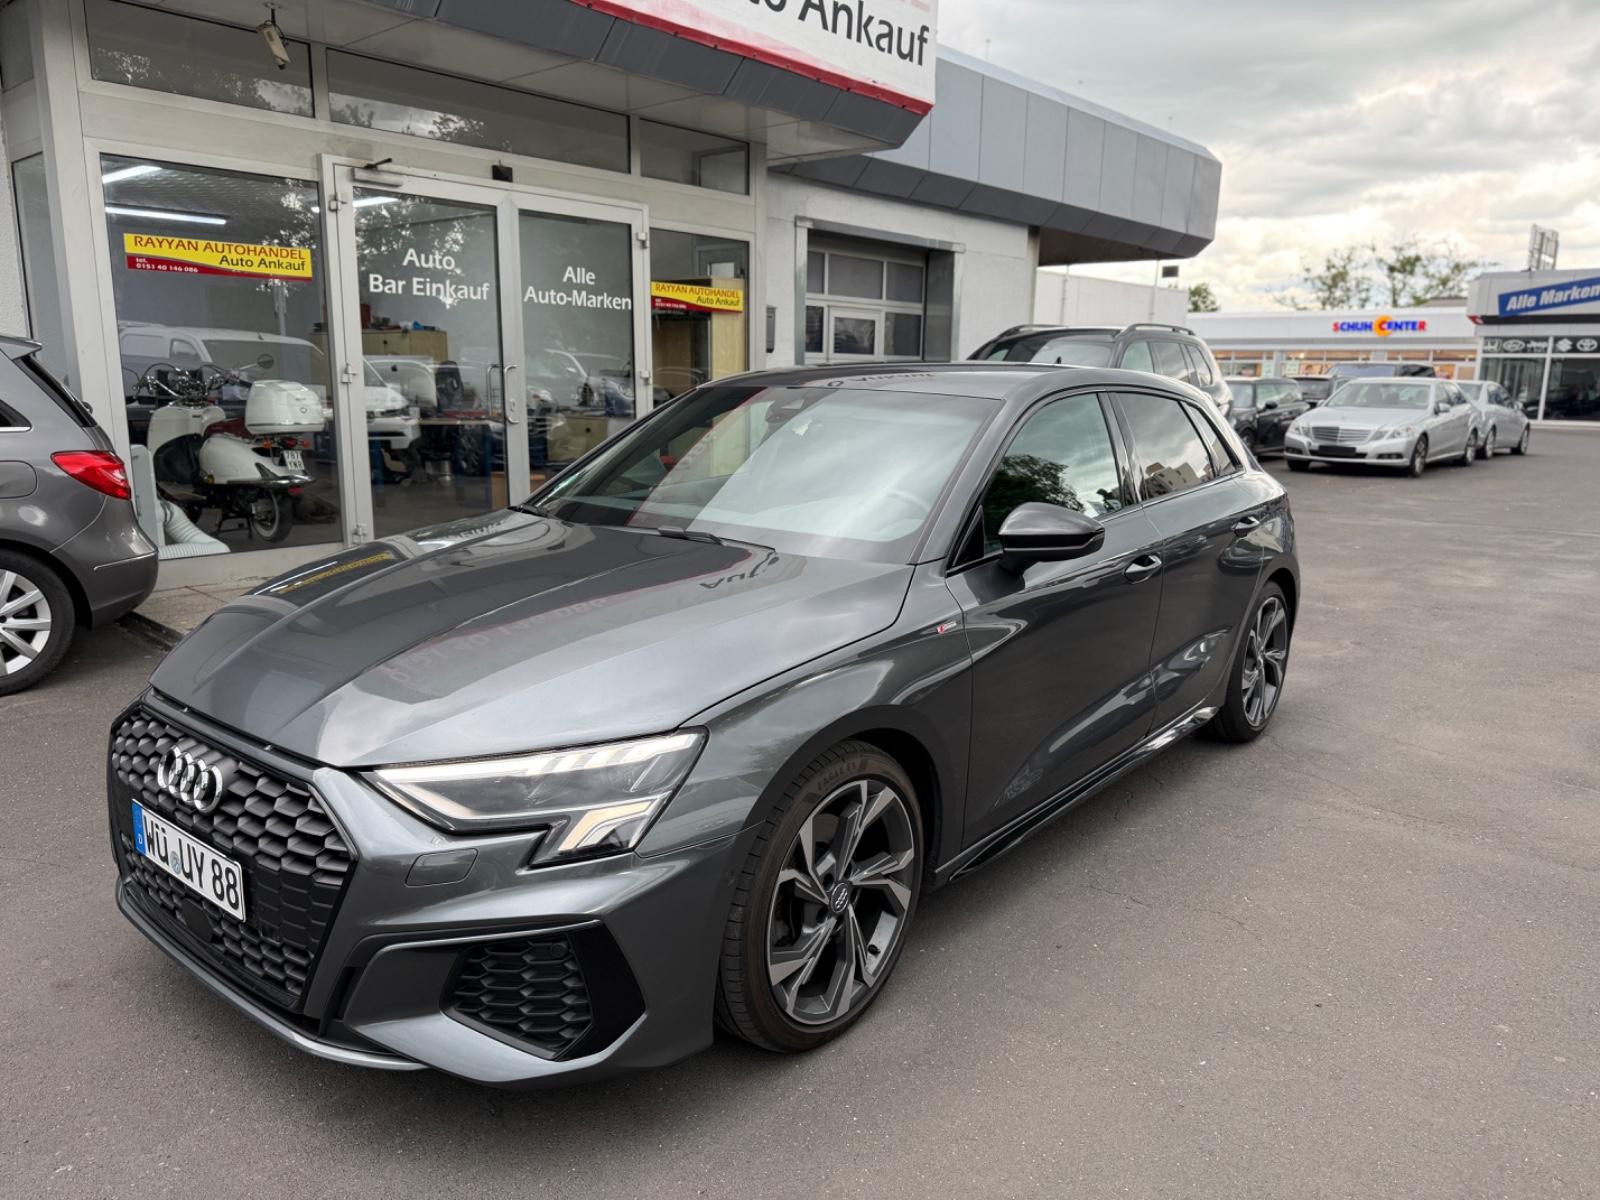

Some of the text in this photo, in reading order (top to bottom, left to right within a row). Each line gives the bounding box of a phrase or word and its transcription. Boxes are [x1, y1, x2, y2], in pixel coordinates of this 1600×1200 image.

[134, 235, 306, 260] RAYYAN AUTOHANDEL
[219, 255, 306, 271] Auto Ankauf
[403, 248, 456, 271] Auto
[562, 266, 596, 285] Alle
[369, 273, 490, 300] Bar Einkauf
[655, 284, 740, 298] RAYYAN AUTOHANDEL
[523, 286, 632, 310] Auto-Marken
[696, 296, 714, 305] Auto
[715, 298, 740, 306] Ankauf
[1506, 294, 1537, 311] Alle
[1333, 316, 1427, 336] SCHUH CENTER
[143, 814, 240, 911] WÜ UY 88
